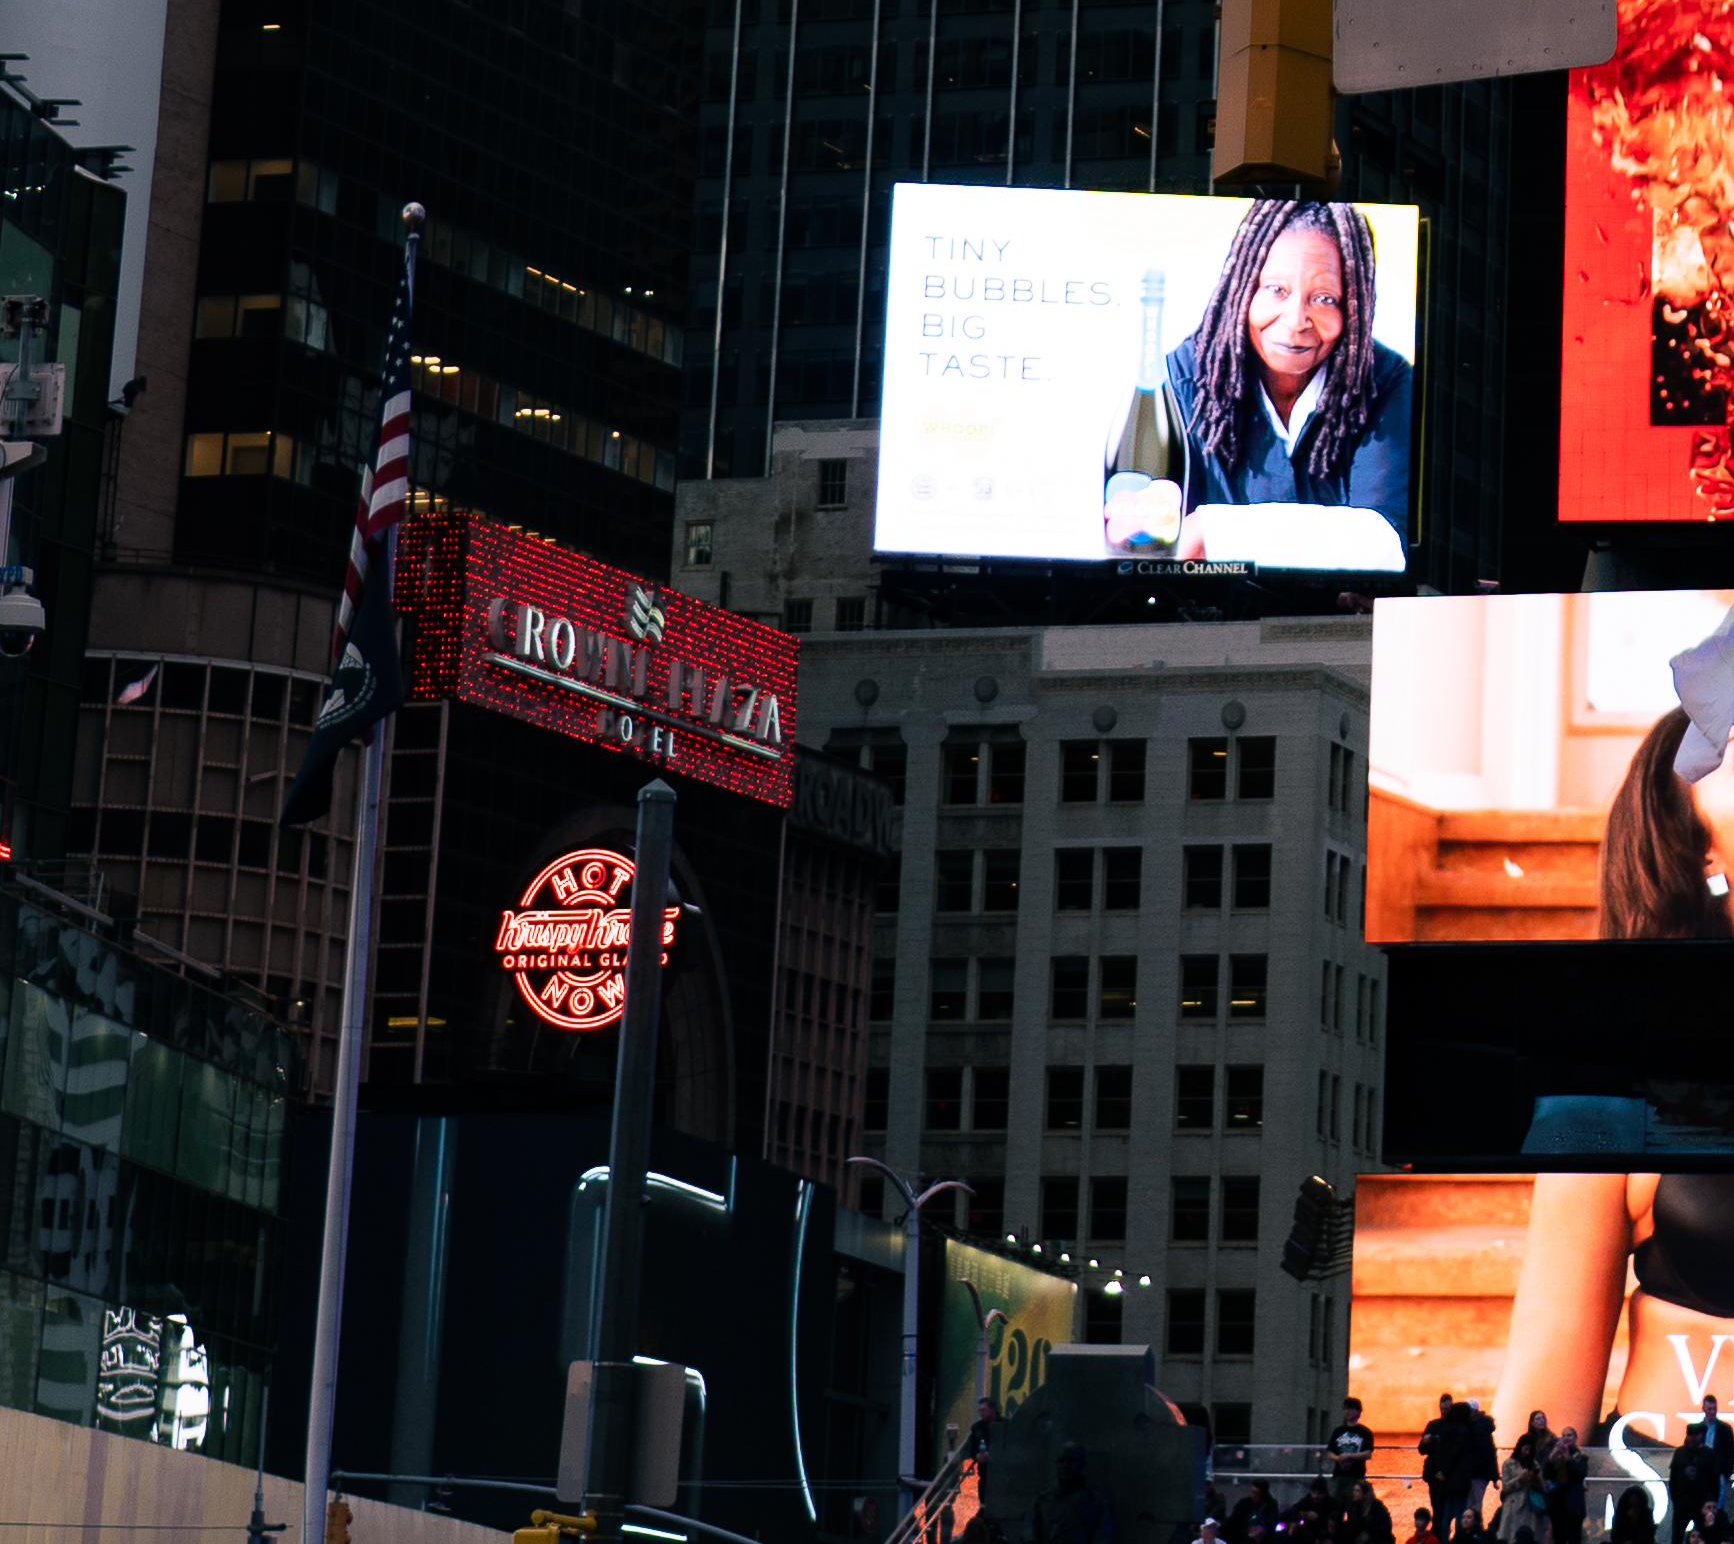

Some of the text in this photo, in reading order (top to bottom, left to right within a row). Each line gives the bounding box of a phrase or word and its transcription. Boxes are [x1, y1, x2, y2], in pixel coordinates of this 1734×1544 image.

[924, 235, 1012, 262] TINY
[923, 274, 1121, 307] BUBBLES.
[922, 313, 986, 340] BIG
[918, 352, 1052, 382] TASTE.
[551, 861, 632, 901] HOT
[496, 908, 681, 954] Krispy Kree
[503, 954, 593, 968] ORIGINAL
[541, 972, 626, 1016] NOW
